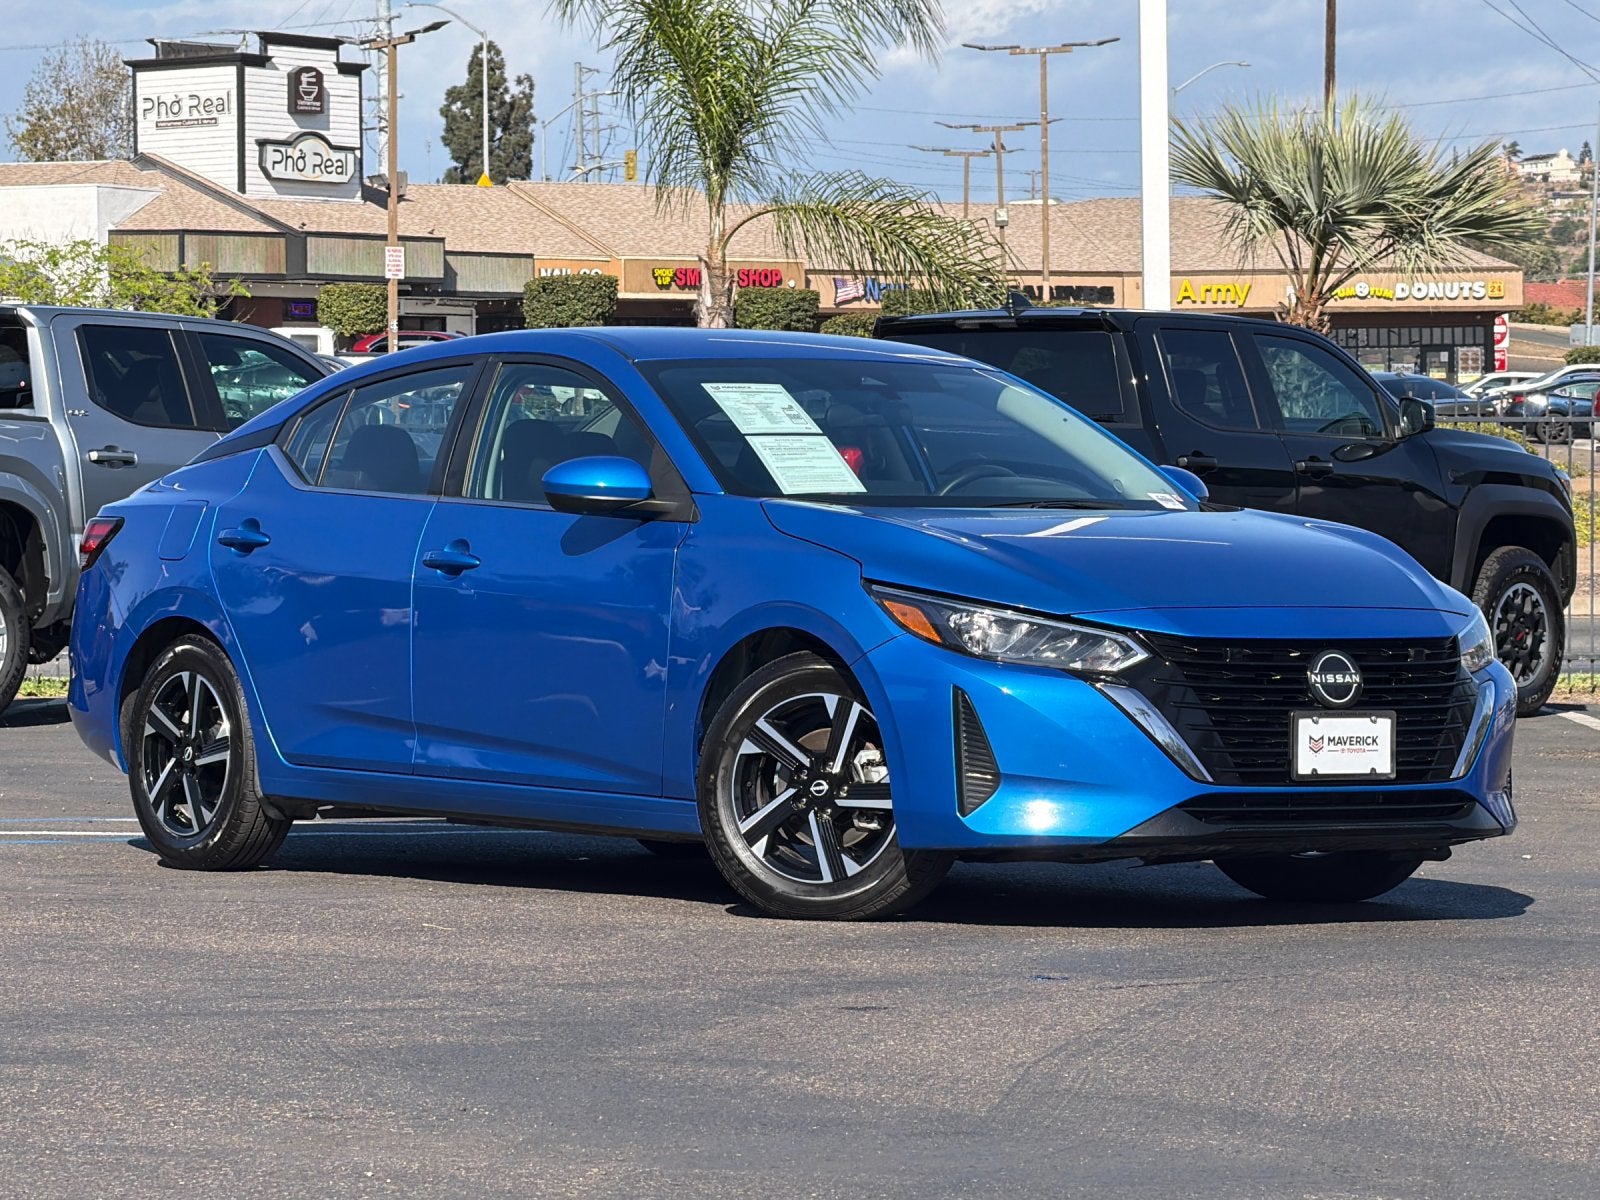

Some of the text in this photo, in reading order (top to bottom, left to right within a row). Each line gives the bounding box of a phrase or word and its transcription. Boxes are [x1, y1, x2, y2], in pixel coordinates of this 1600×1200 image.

[188, 90, 231, 116] Real
[312, 152, 348, 176] Real
[653, 268, 674, 277] SMOKE
[738, 268, 783, 288] SHOP
[657, 276, 662, 285] &
[662, 276, 671, 285] UP
[1176, 278, 1252, 307] Army
[1369, 286, 1393, 299] YUM
[1395, 281, 1487, 300] DONUTS
[1489, 284, 1502, 293] 24
[1311, 673, 1360, 683] NISSAN
[1327, 735, 1379, 747] MAVERICK
